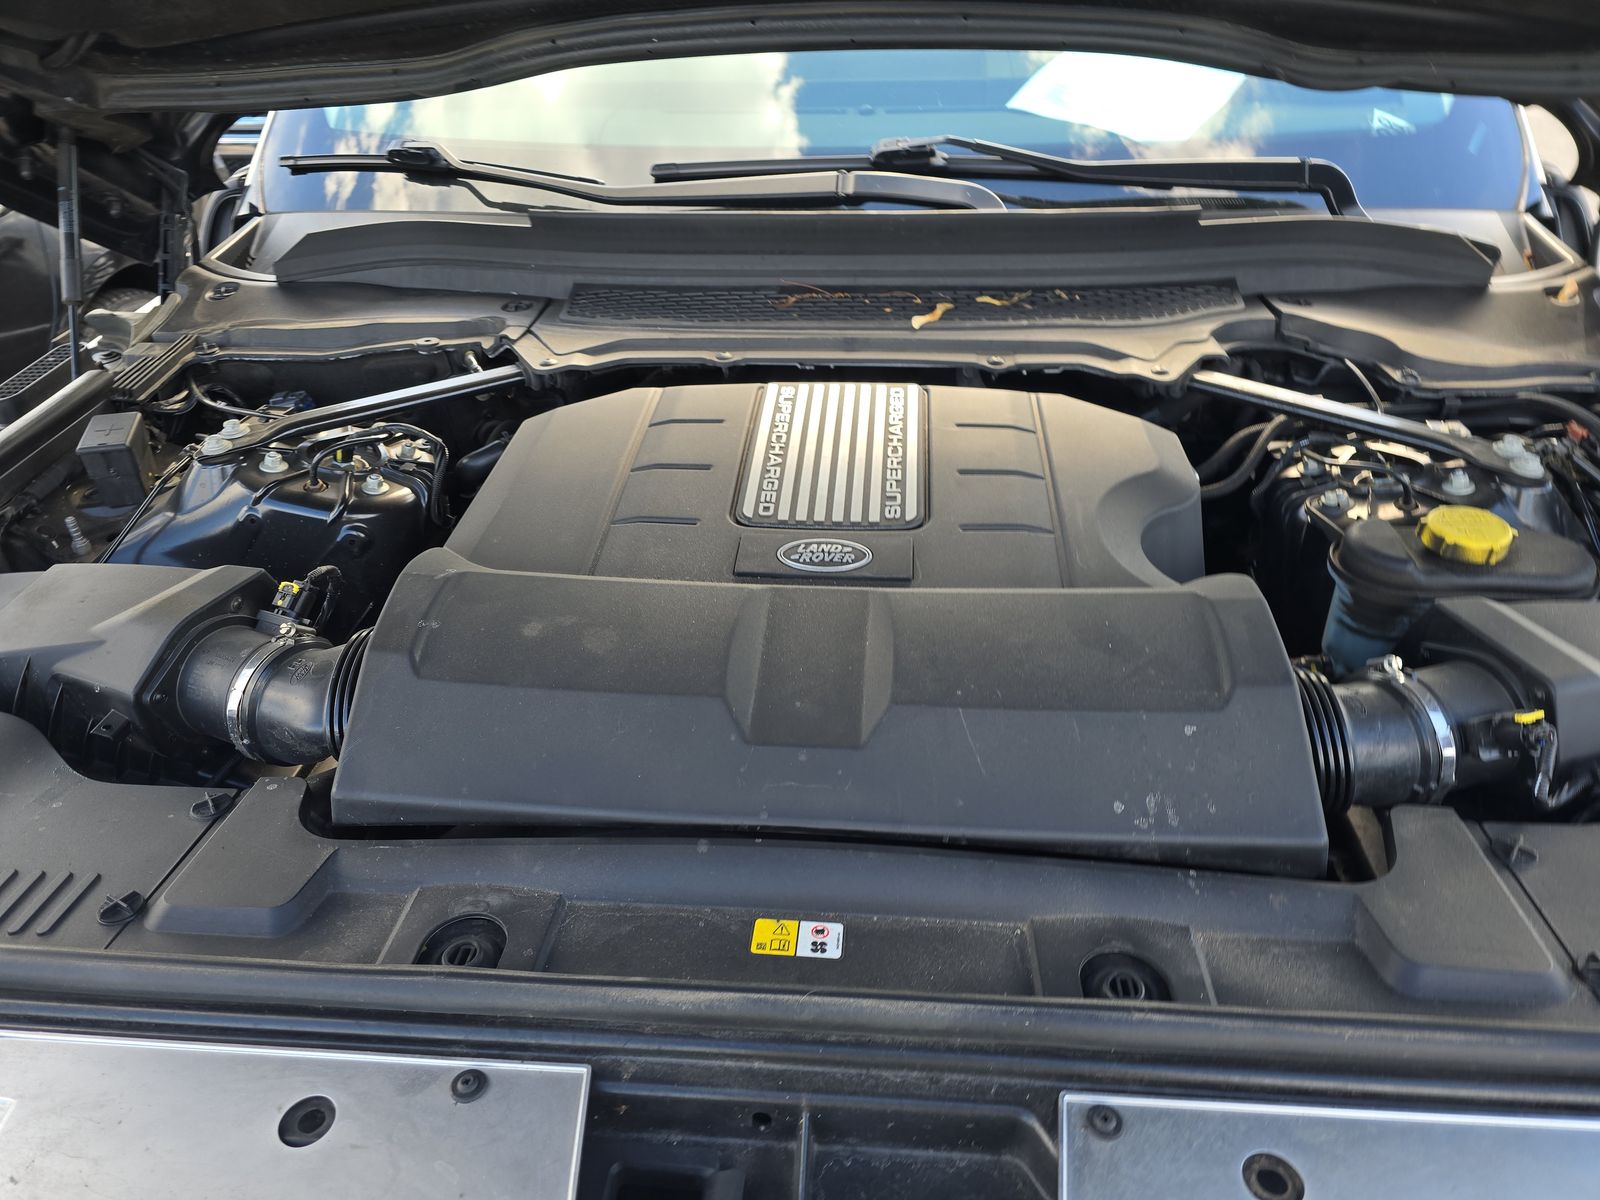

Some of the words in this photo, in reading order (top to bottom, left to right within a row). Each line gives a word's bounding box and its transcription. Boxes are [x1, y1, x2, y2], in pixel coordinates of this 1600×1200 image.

[758, 385, 796, 517] SUPERCHARGED
[884, 386, 905, 519] SUPERCHARGED
[797, 543, 844, 553] LAND
[798, 553, 855, 563] ROVER
